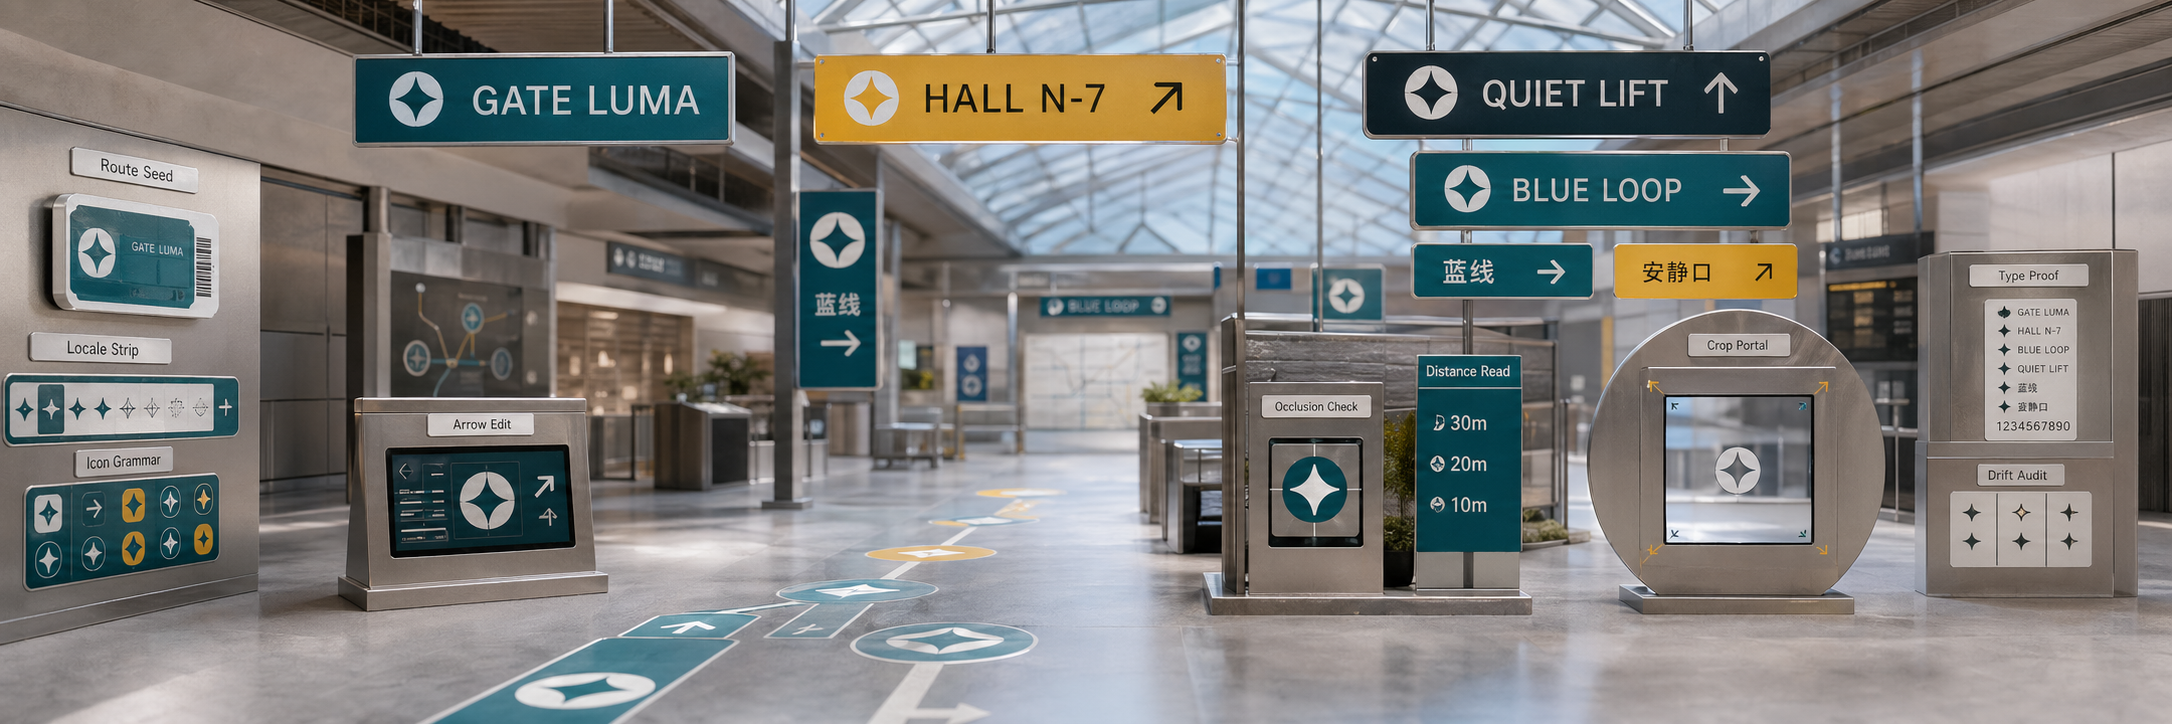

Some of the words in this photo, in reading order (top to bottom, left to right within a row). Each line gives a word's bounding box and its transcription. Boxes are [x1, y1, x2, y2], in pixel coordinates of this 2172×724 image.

[473, 85, 572, 116] GATE
[588, 85, 700, 115] LUMA
[925, 83, 1024, 113] HALL
[1041, 83, 1105, 113] N-7
[1482, 79, 1585, 110] QUIET
[1600, 79, 1668, 107] LIFT
[101, 158, 138, 176] Route
[144, 166, 173, 182] Seed
[1513, 178, 1589, 202] BLUE
[1603, 178, 1682, 202] LOOP
[132, 242, 155, 254] GATE
[159, 244, 184, 256] LUMA
[1443, 259, 1495, 285] 蓝线
[1642, 260, 1711, 284] 安静口
[1999, 270, 2025, 283] Type
[2030, 270, 2059, 280] Proof
[815, 292, 860, 316] 蓝线
[2018, 308, 2040, 316] GATE
[2044, 308, 2070, 316] LUMA
[2018, 327, 2041, 335] HALL
[2045, 327, 2061, 335] N-7
[68, 340, 107, 355] Locale
[112, 342, 139, 359] Strip
[1707, 340, 1733, 352] Crop
[1736, 339, 1768, 350] Portal
[2018, 346, 2041, 354] BLUE
[2045, 346, 2070, 354] LOOP
[1426, 365, 1477, 377] Distance
[1481, 365, 1510, 377] Read
[2018, 365, 2046, 374] QUIET
[2049, 365, 2069, 373] LIFT
[1275, 402, 1324, 411] Occlusion
[1328, 402, 1358, 411] Check
[453, 419, 487, 429] Arrow
[491, 419, 511, 429] Edit
[1450, 414, 1487, 431] 30m
[1996, 421, 2070, 431] 1234567890
[87, 456, 110, 469] Icon
[113, 455, 161, 468] Grammar
[1450, 456, 1487, 472] 20m
[1988, 470, 2013, 480] Drift
[2017, 470, 2047, 480] Audit
[1450, 496, 1487, 512] 10m
